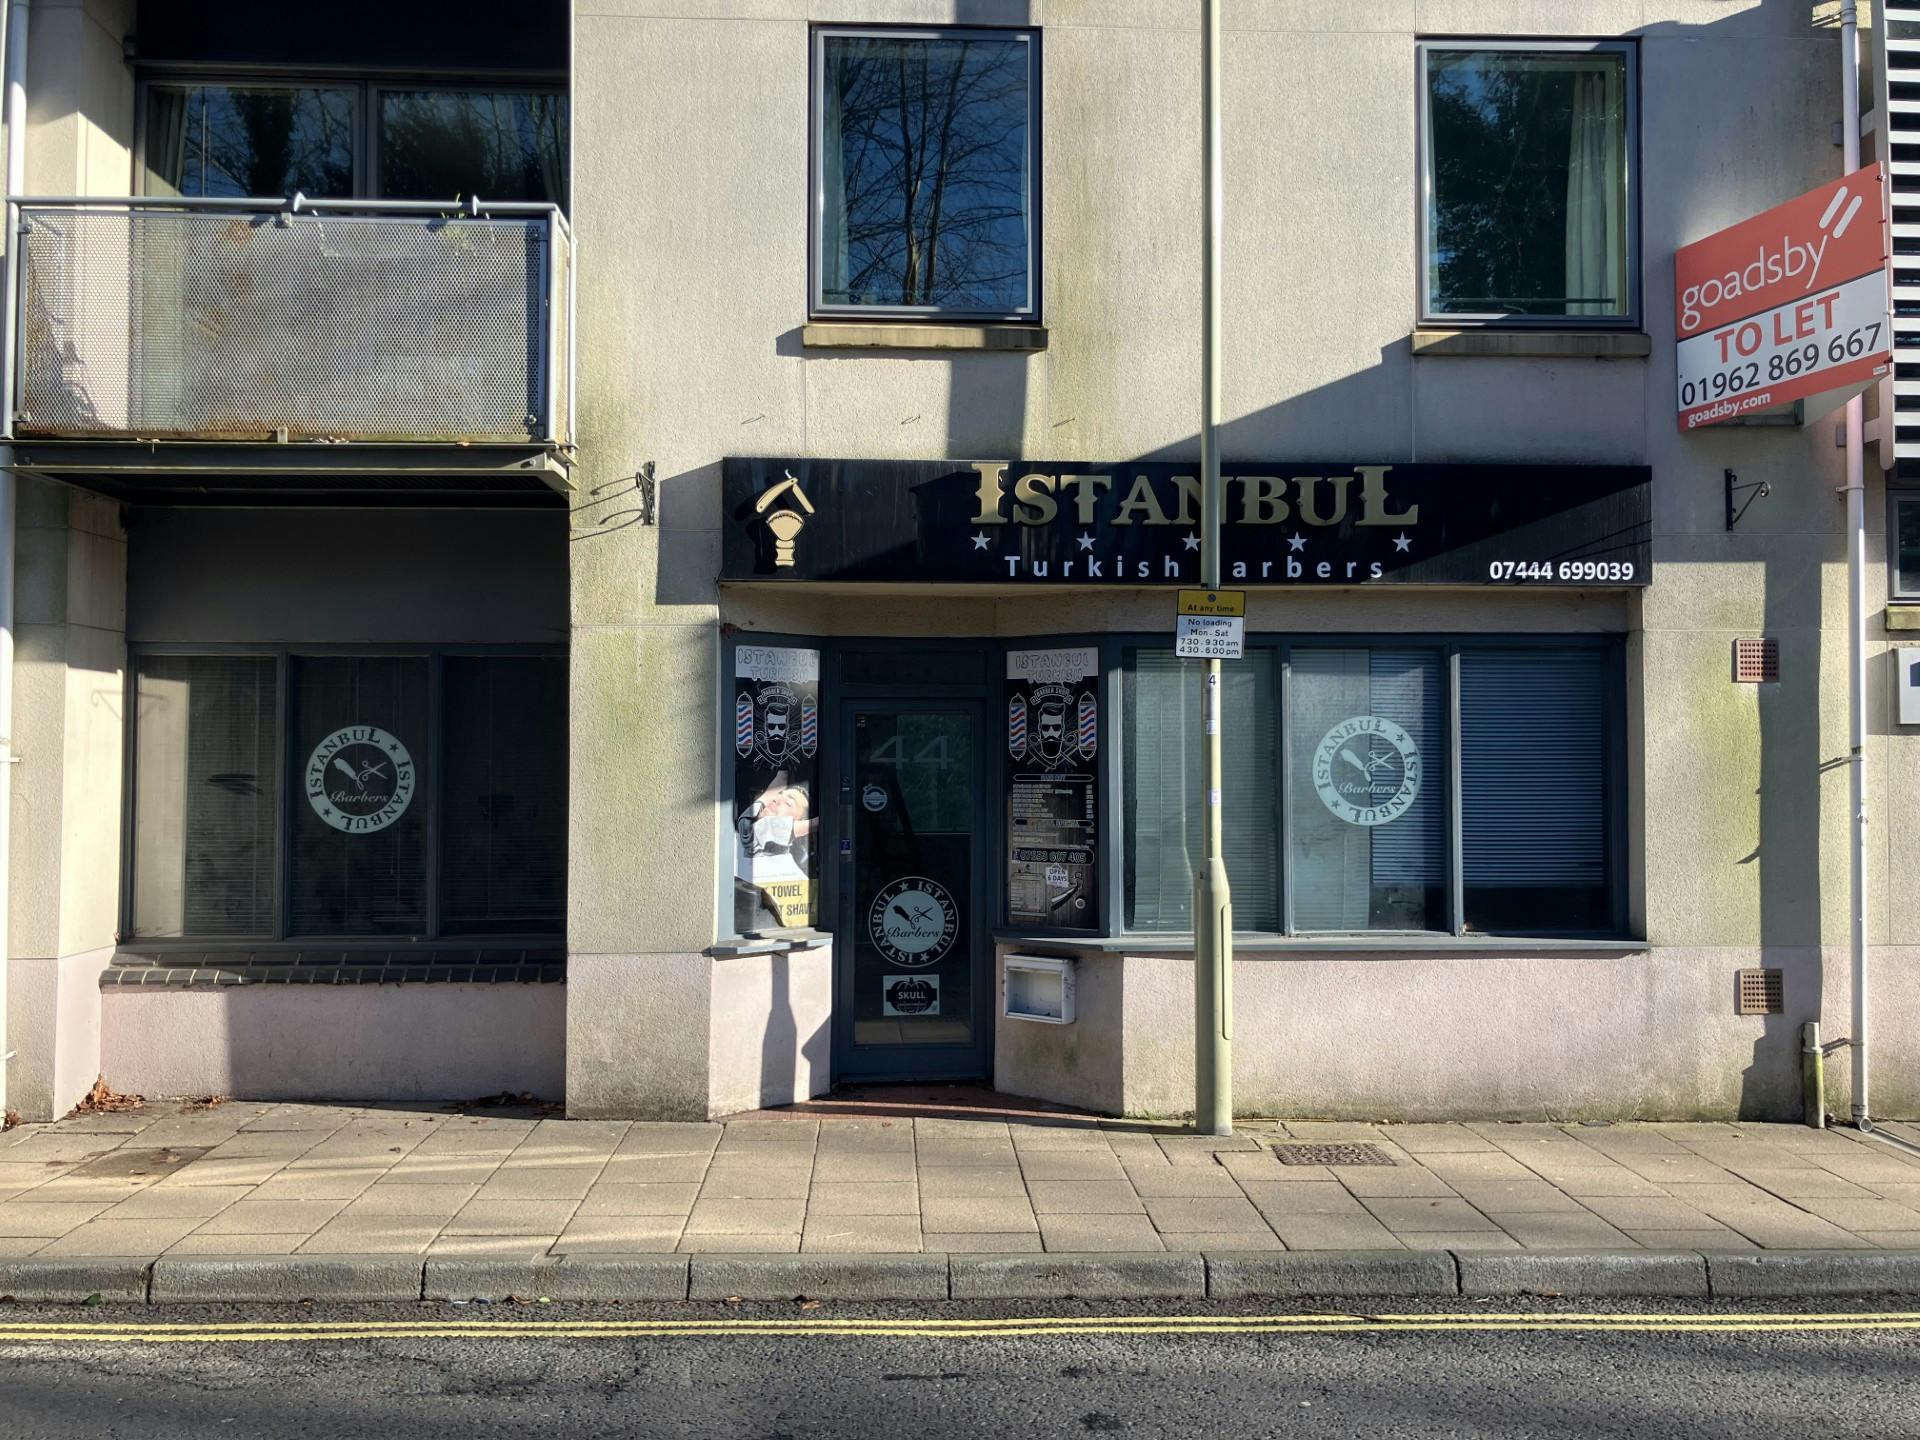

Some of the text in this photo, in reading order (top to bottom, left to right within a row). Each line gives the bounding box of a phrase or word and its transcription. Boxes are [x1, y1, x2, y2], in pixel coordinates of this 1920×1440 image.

[1681, 234, 1828, 330] goadsby
[1714, 291, 1840, 364] TO LET
[1681, 322, 1882, 406] 01962 869 667
[1687, 392, 1771, 428] goadsby.com
[1004, 555, 1383, 579] Turkish arbers
[1489, 561, 1634, 581] 07444 699039
[1187, 604, 1234, 613] At any time
[1188, 618, 1232, 627] No loading
[1190, 628, 1208, 636] Mon
[1214, 629, 1229, 637] Sat
[309, 727, 381, 800] ISTANBUL
[1317, 719, 1387, 790] ISTANBUL
[330, 790, 389, 803] Barbers
[340, 759, 411, 830] ISTANBUL
[1338, 781, 1397, 794] Barbers
[1349, 751, 1418, 823] ISTANBUL
[771, 885, 803, 898] TOWEL
[872, 891, 913, 964] ISTANBUL
[886, 926, 941, 938] Barbers
[917, 880, 955, 954] ISTANBUL
[897, 991, 926, 1000] SKULL
